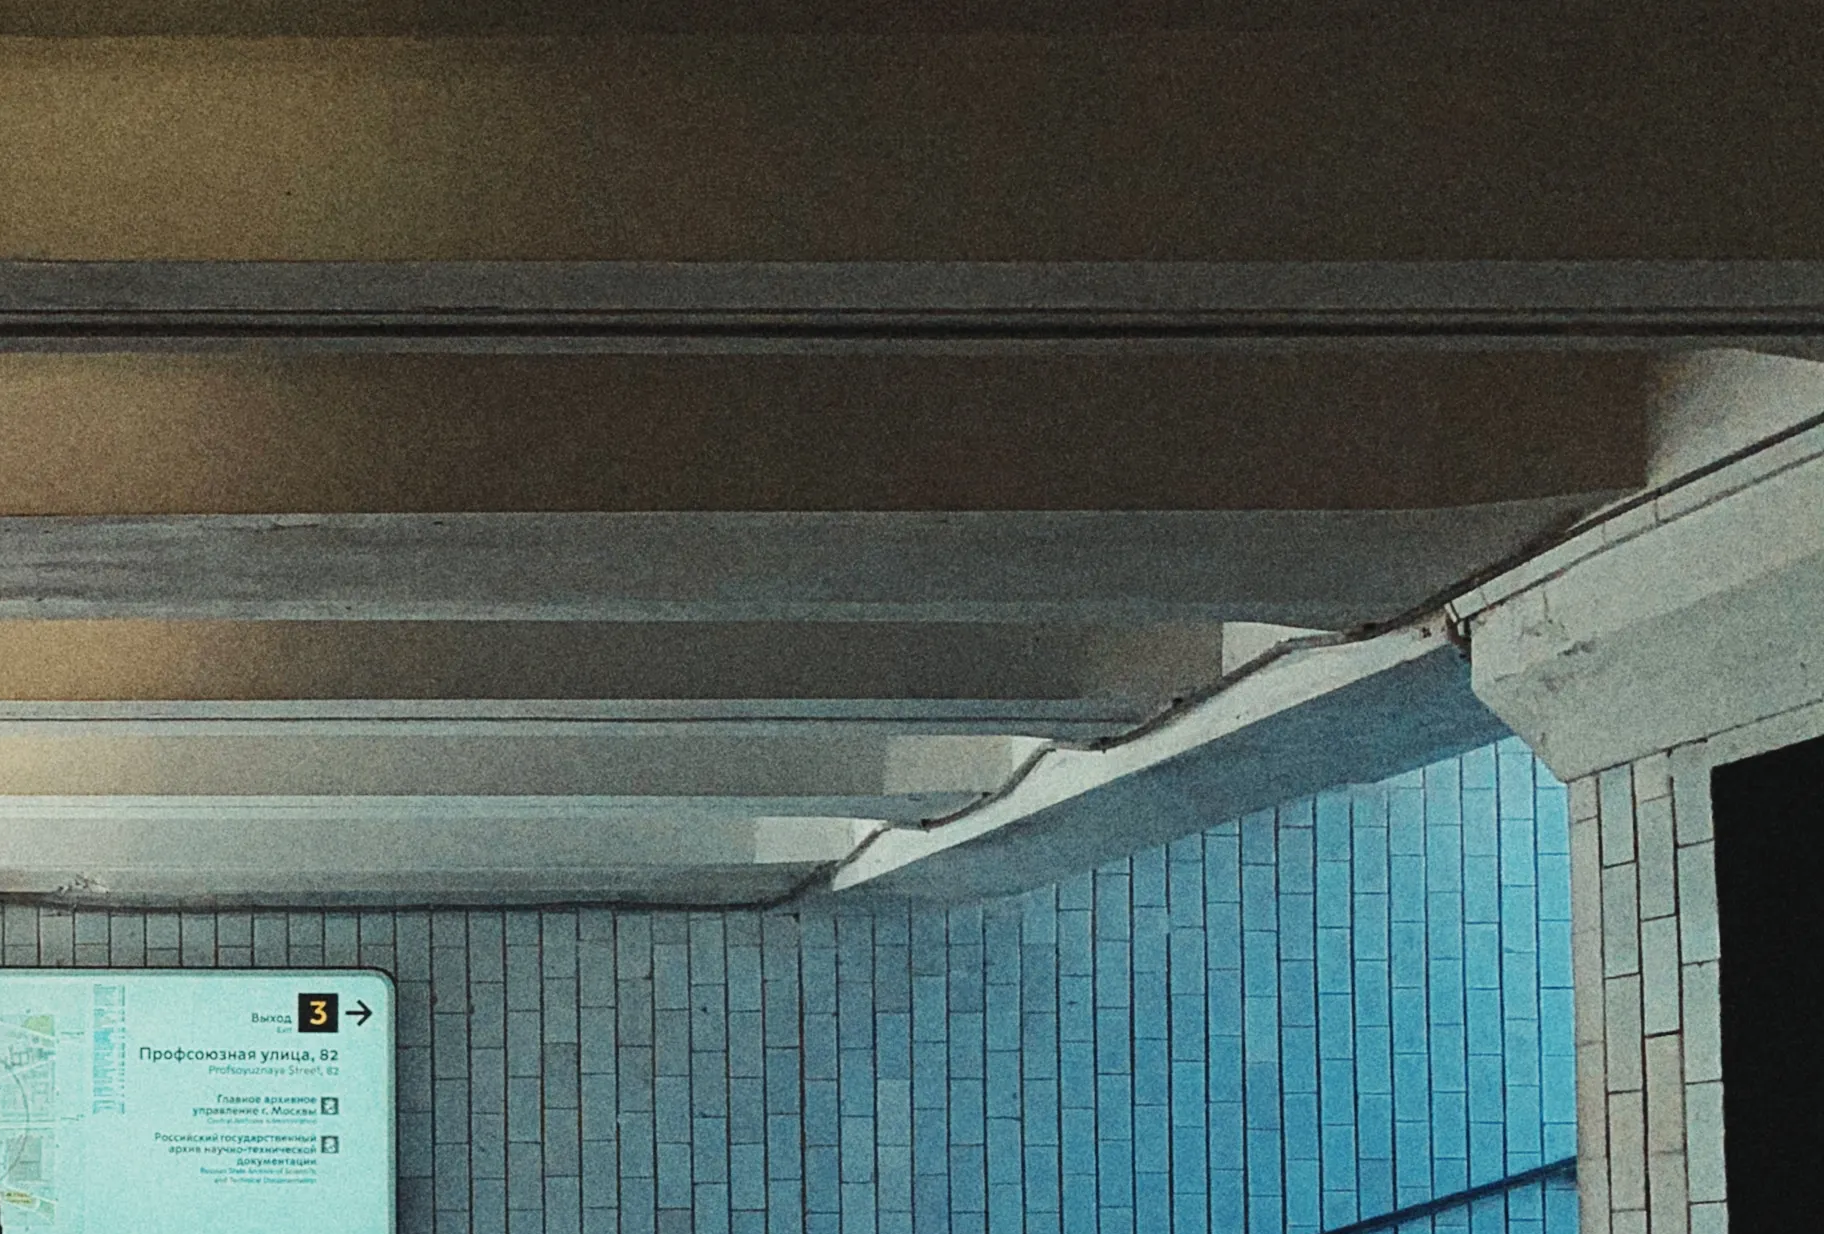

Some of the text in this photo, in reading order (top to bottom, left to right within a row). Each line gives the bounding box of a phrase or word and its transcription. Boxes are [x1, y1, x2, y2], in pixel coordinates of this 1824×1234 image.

[252, 1013, 292, 1023] Выход
[309, 1000, 327, 1025] 3
[139, 1047, 338, 1062] Профсоюзная улица, 82
[209, 1065, 339, 1076] Profsoyuznaya Street, 82
[217, 1095, 317, 1106] Главное архивное
[193, 1106, 259, 1116] управление
[273, 1106, 317, 1116] Москвы
[155, 1132, 317, 1144] Российский государственный
[169, 1144, 317, 1155] архив научно-технической
[236, 1157, 317, 1167] документации
